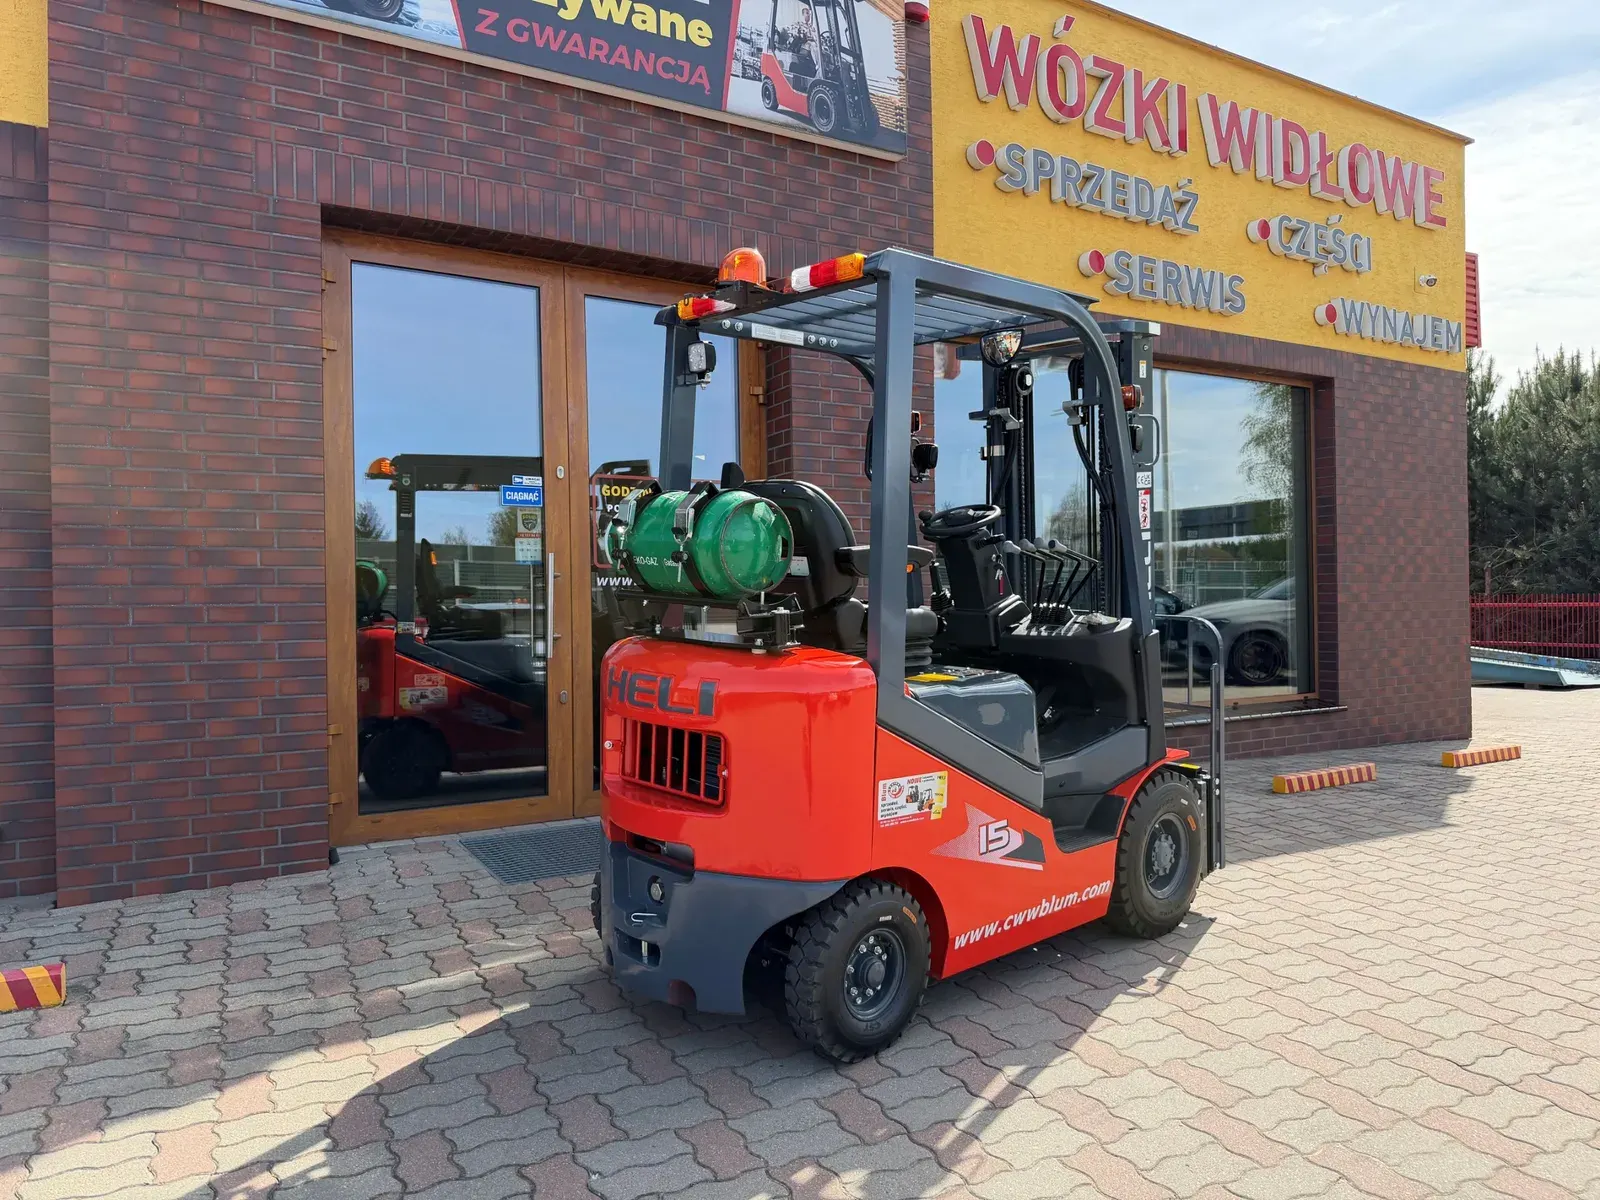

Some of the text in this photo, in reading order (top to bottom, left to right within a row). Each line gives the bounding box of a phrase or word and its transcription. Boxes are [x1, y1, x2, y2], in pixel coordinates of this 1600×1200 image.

[475, 8, 712, 95] Z GWARANCJĄ
[962, 14, 1448, 230] WÓZKI WIDŁOWE
[995, 143, 1200, 236] SPRZEDAŻ
[1268, 213, 1373, 276] CZĘŚCI
[1104, 249, 1246, 317] SERWIS
[1334, 296, 1463, 354] WYNAJEM
[505, 490, 539, 503] CIĄGNĄĆ
[607, 665, 718, 717] HELI
[978, 819, 1011, 856] 15
[953, 879, 1112, 951] www.cwwblum.com
